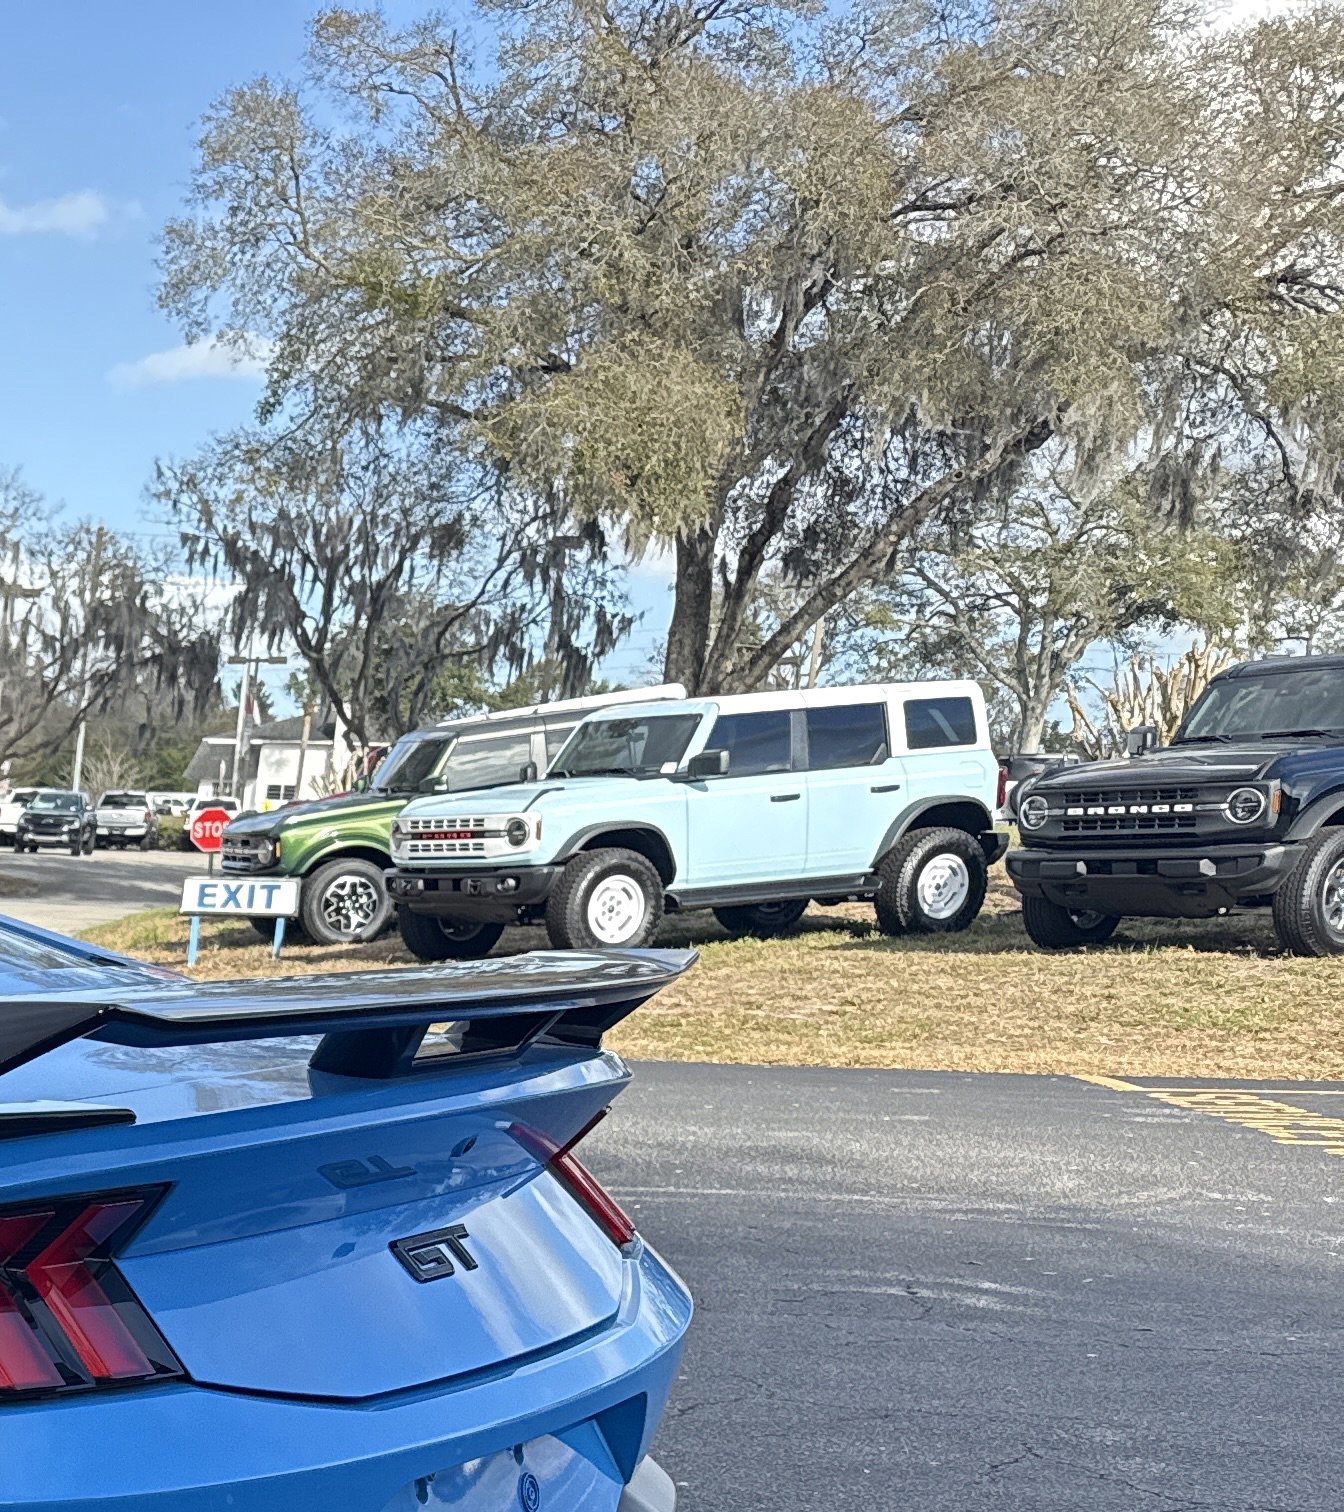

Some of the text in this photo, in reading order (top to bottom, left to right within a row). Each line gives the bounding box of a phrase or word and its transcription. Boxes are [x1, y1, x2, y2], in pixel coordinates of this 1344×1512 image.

[1067, 803, 1193, 816] BRONCO
[197, 883, 282, 910] EXIT
[388, 1223, 479, 1284] GT
